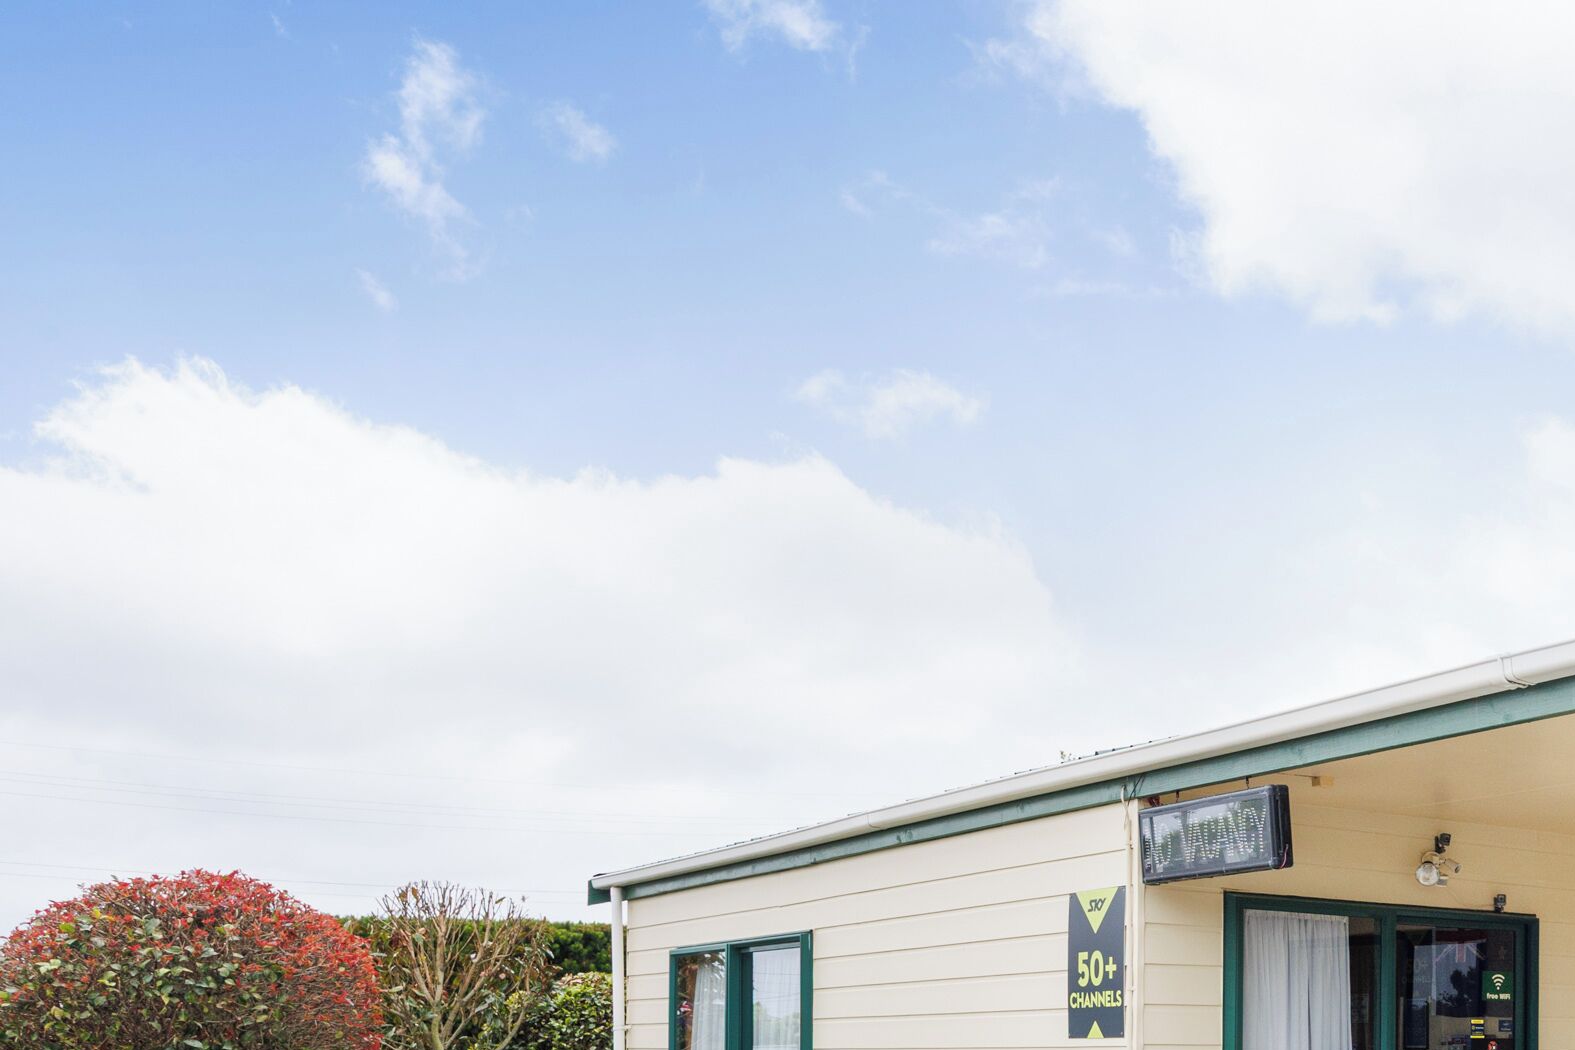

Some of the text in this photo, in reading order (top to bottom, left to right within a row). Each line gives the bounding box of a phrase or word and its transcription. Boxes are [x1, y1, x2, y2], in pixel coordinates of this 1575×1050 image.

[1145, 805, 1267, 868] NO VACANCY
[1088, 898, 1106, 912] SKY
[1077, 949, 1117, 987] 50+
[1069, 989, 1122, 1009] CHANNELS
